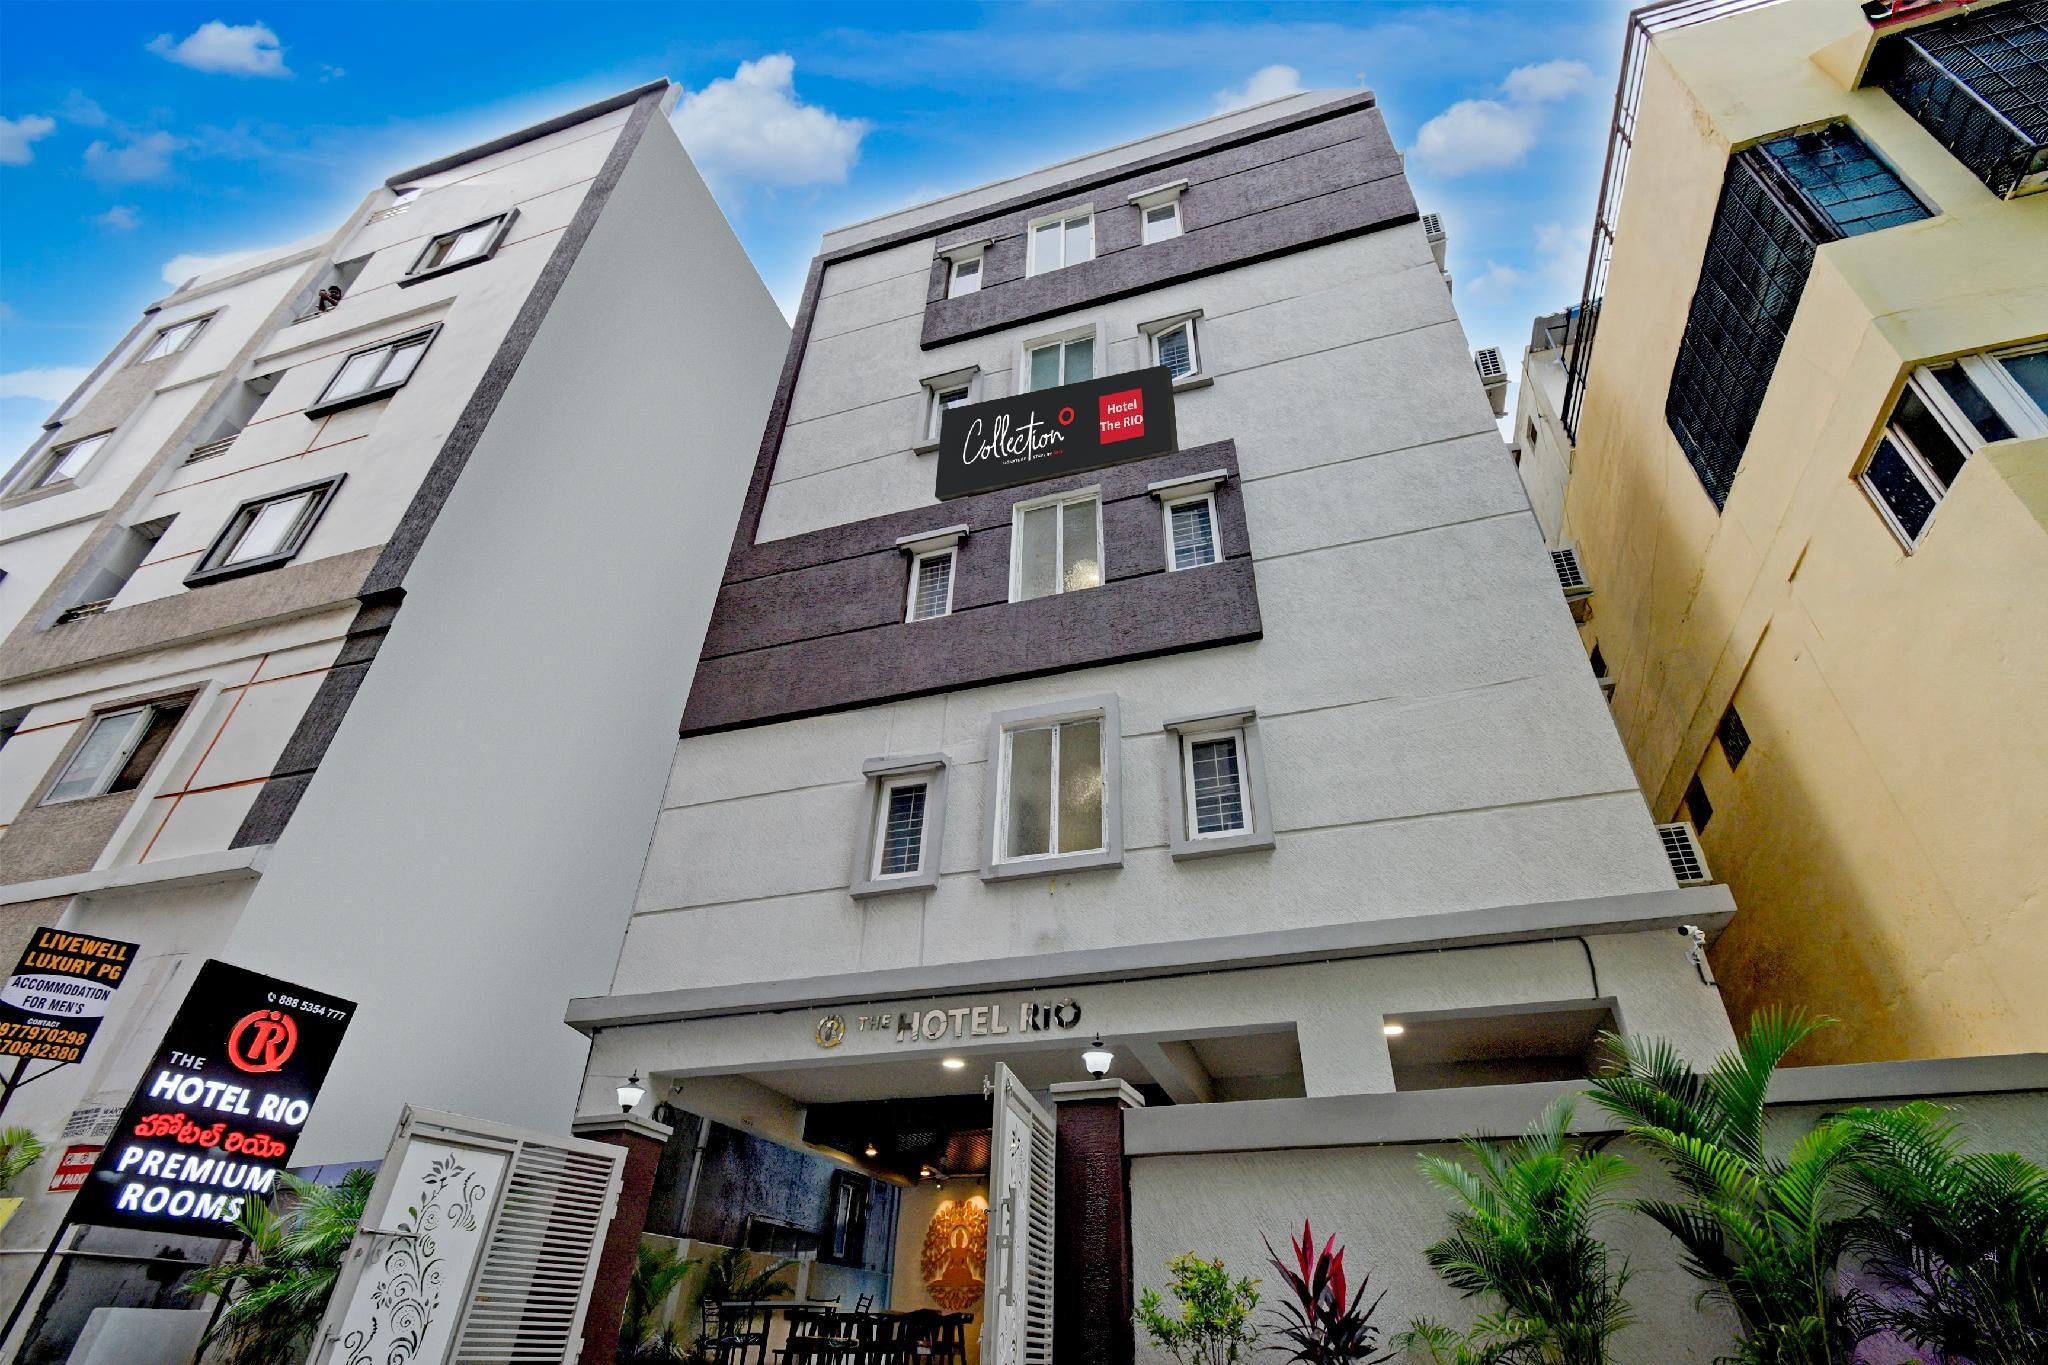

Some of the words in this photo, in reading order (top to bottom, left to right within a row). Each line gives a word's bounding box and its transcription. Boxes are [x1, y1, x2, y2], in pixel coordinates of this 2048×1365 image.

[1107, 399, 1138, 414] Hotel
[1100, 419, 1121, 432] The
[1123, 414, 1144, 427] RIO
[963, 411, 1065, 465] Collection
[39, 932, 127, 961] LIVEWELL
[25, 951, 96, 975] LUXURY
[97, 964, 122, 980] PG
[12, 976, 111, 1001] ACCOMMODATION
[22, 995, 47, 1009] FOR
[48, 999, 85, 1014] MEN'S
[278, 995, 299, 1008] 888
[300, 1001, 326, 1016] 5354
[326, 1008, 347, 1021] 777
[27, 1018, 60, 1028] CONTACT
[859, 1014, 891, 1031] THE
[897, 1005, 1009, 1041] HOTEL
[1019, 999, 1082, 1032] RIO
[0, 1022, 87, 1046] 977970298
[0, 1040, 80, 1061] 70842380
[169, 1051, 207, 1071] THE
[149, 1071, 251, 1115] HOTEL
[257, 1093, 310, 1126] RIO
[117, 1146, 277, 1193] PREMIUM
[116, 1183, 245, 1223] ROOMS
